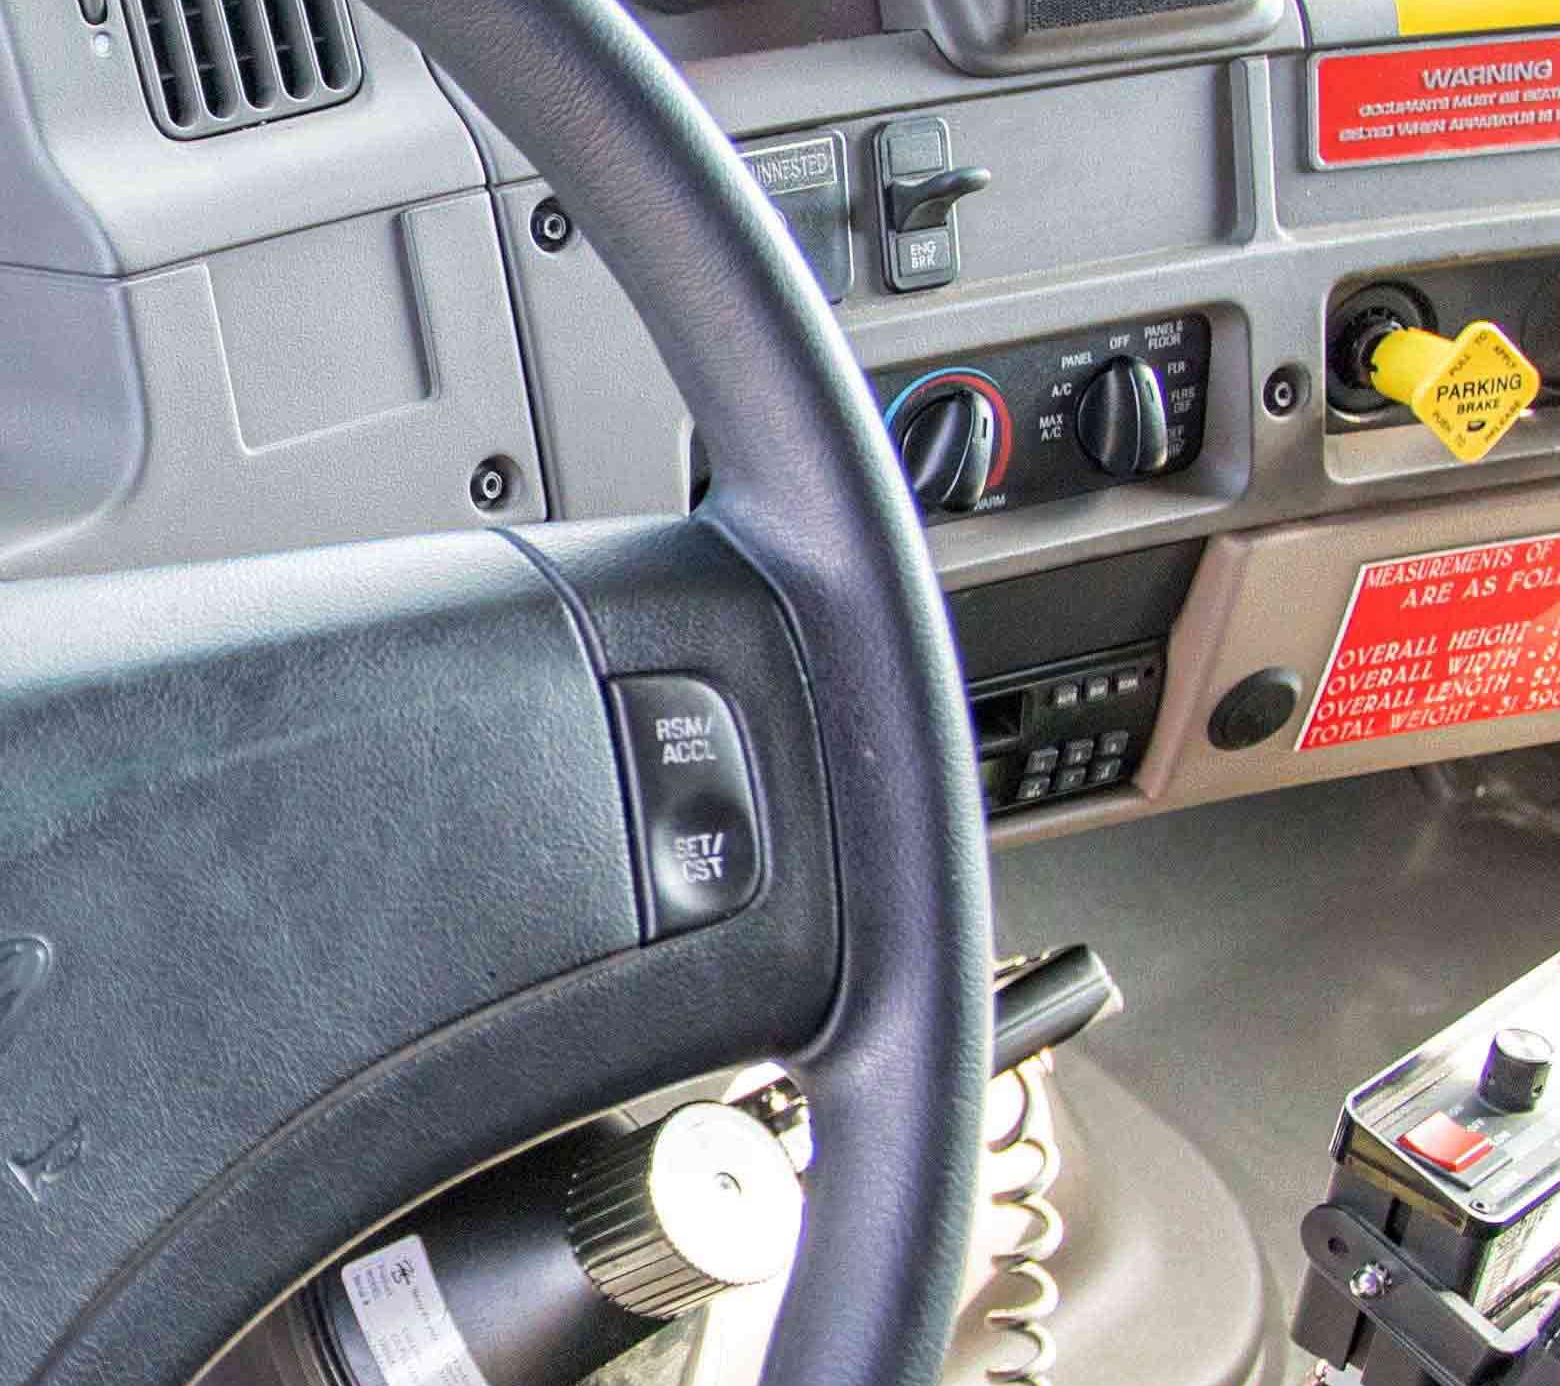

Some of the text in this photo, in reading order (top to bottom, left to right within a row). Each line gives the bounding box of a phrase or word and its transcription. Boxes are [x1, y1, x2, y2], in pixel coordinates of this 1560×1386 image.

[1421, 59, 1552, 89] WARNING
[910, 241, 937, 257] ENG
[1109, 334, 1131, 350] OFF
[1061, 351, 1093, 369] PANEL
[1051, 382, 1072, 398] A/C
[1436, 373, 1522, 403] PARKING
[1456, 398, 1500, 415] BRAKE
[1039, 413, 1064, 429] MAX
[1040, 425, 1064, 440] A/C
[1365, 545, 1513, 590] MEASUREMENTS
[1525, 541, 1552, 563] OF
[1400, 580, 1450, 610] ARE
[1462, 571, 1497, 599] AS
[1336, 620, 1533, 672] OVERALL HEIGHT
[1326, 648, 1521, 696] OVERALL WIDTH
[1316, 674, 1511, 721] OVERALL LENGTH
[655, 715, 713, 742] RSM/
[1307, 704, 1482, 746] TOTAL WEIGHT
[662, 738, 719, 764] ACCL
[673, 832, 725, 859] SET/
[682, 856, 724, 885] CST
